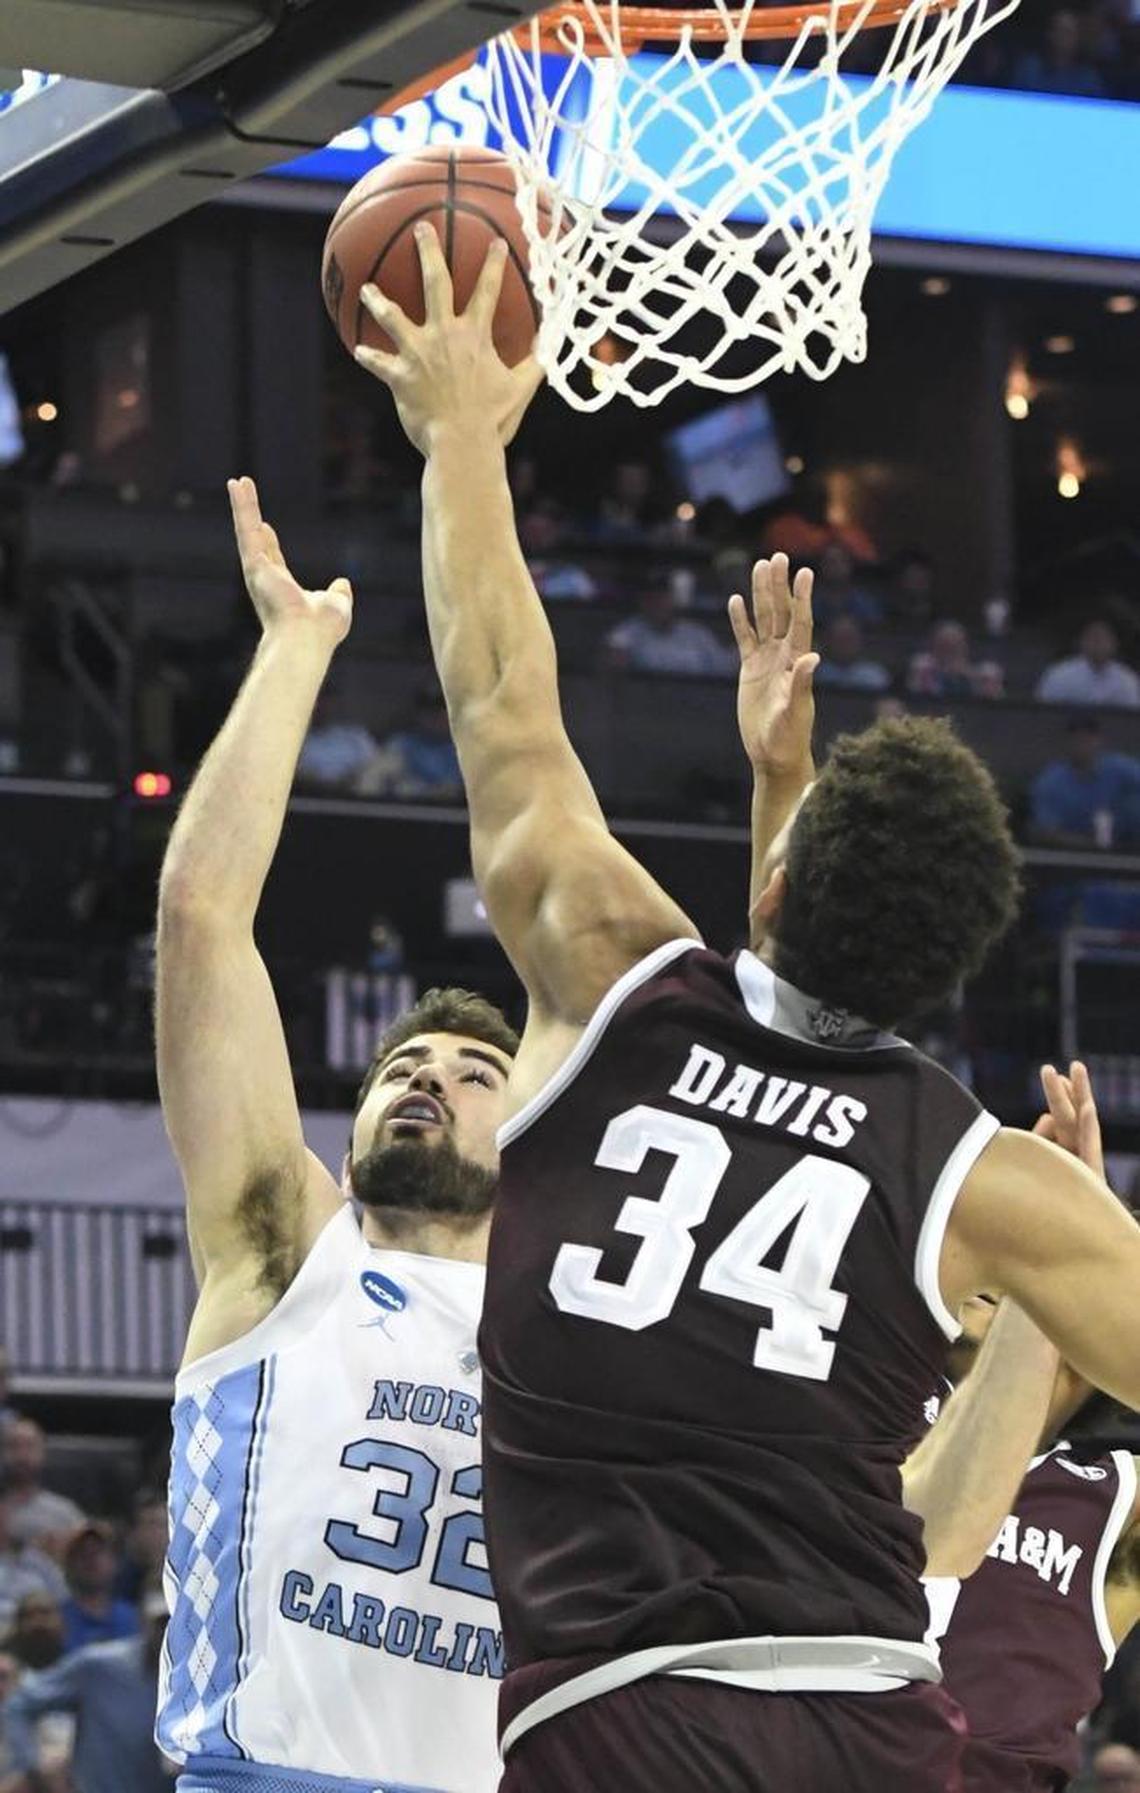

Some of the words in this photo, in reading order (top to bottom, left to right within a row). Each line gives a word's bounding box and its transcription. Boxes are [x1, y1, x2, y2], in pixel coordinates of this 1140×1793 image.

[325, 63, 489, 152] SS
[668, 1043, 868, 1148] DAVIS
[548, 1104, 871, 1381] 34
[364, 1279, 404, 1311] NCAA
[366, 1380, 483, 1437] NOR
[323, 1438, 497, 1600] 32
[985, 1514, 1083, 1596] A&M
[279, 1569, 507, 1680] CAROLIN
